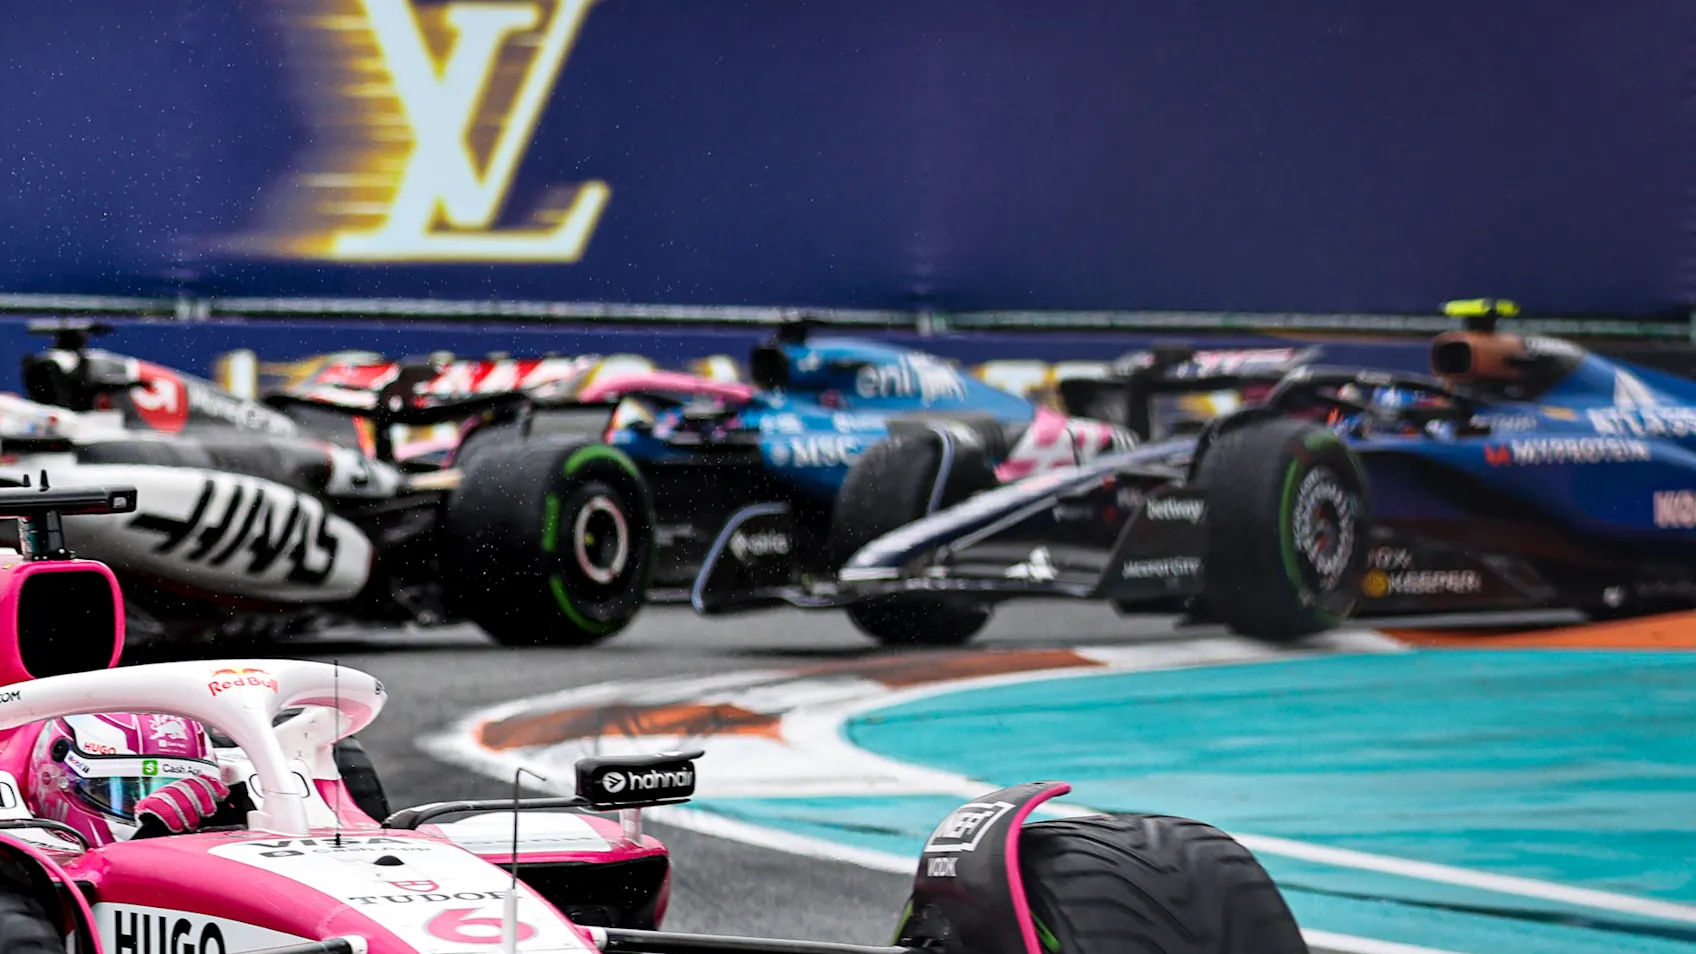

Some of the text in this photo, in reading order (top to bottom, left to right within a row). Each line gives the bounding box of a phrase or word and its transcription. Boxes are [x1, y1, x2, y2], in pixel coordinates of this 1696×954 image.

[1511, 438, 1651, 467] MYPROTEIN
[128, 480, 338, 585] HAAS
[207, 676, 279, 697] Red Bull
[83, 741, 117, 755] HUGO
[162, 763, 185, 774] Cash
[348, 891, 524, 905] TUDOR
[422, 906, 540, 945] 6
